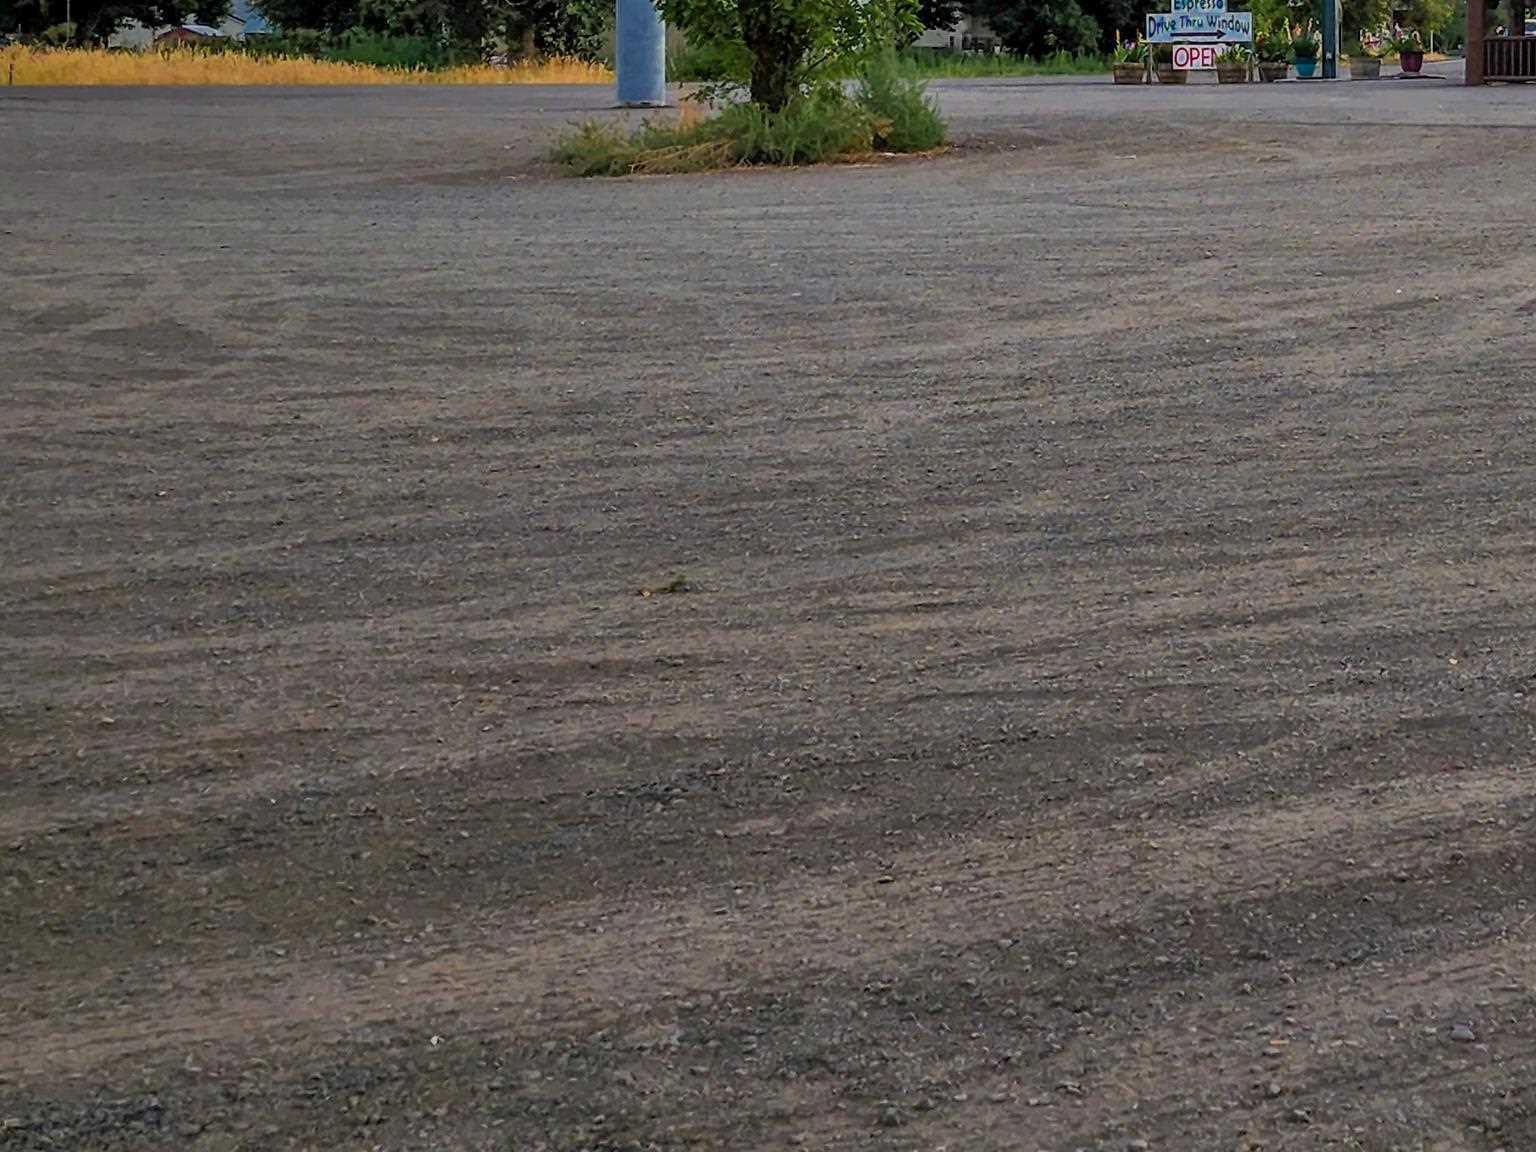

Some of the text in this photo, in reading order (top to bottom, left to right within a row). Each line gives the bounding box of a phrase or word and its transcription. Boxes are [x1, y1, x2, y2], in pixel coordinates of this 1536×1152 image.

[1148, 15, 1250, 38] Drive Thru Window
